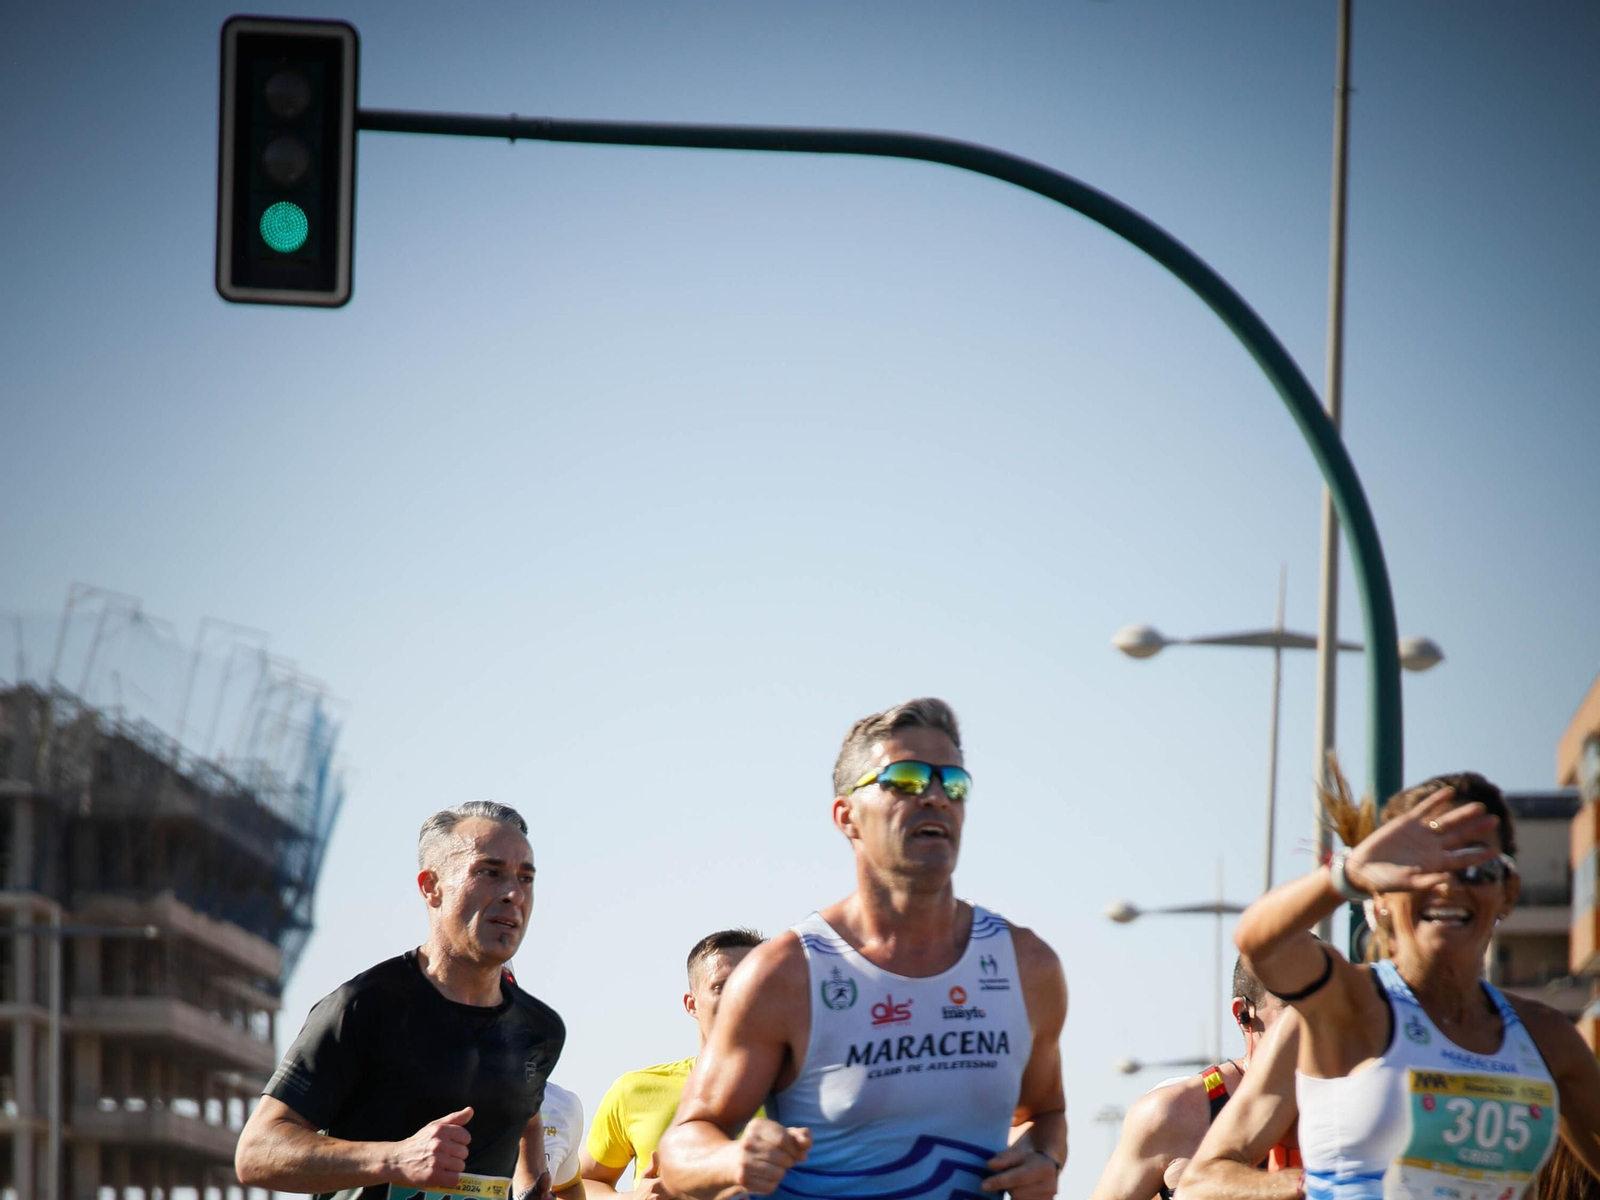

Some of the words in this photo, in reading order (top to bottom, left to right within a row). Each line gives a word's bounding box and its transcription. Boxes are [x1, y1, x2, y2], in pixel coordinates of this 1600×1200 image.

[846, 1030, 1010, 1068] MARACENA
[867, 1066, 902, 1079] CLUB
[906, 1064, 922, 1073] DE
[926, 1060, 998, 1071] ATLETISMO
[1443, 1097, 1530, 1152] 305
[462, 1184, 480, 1193] 2024
